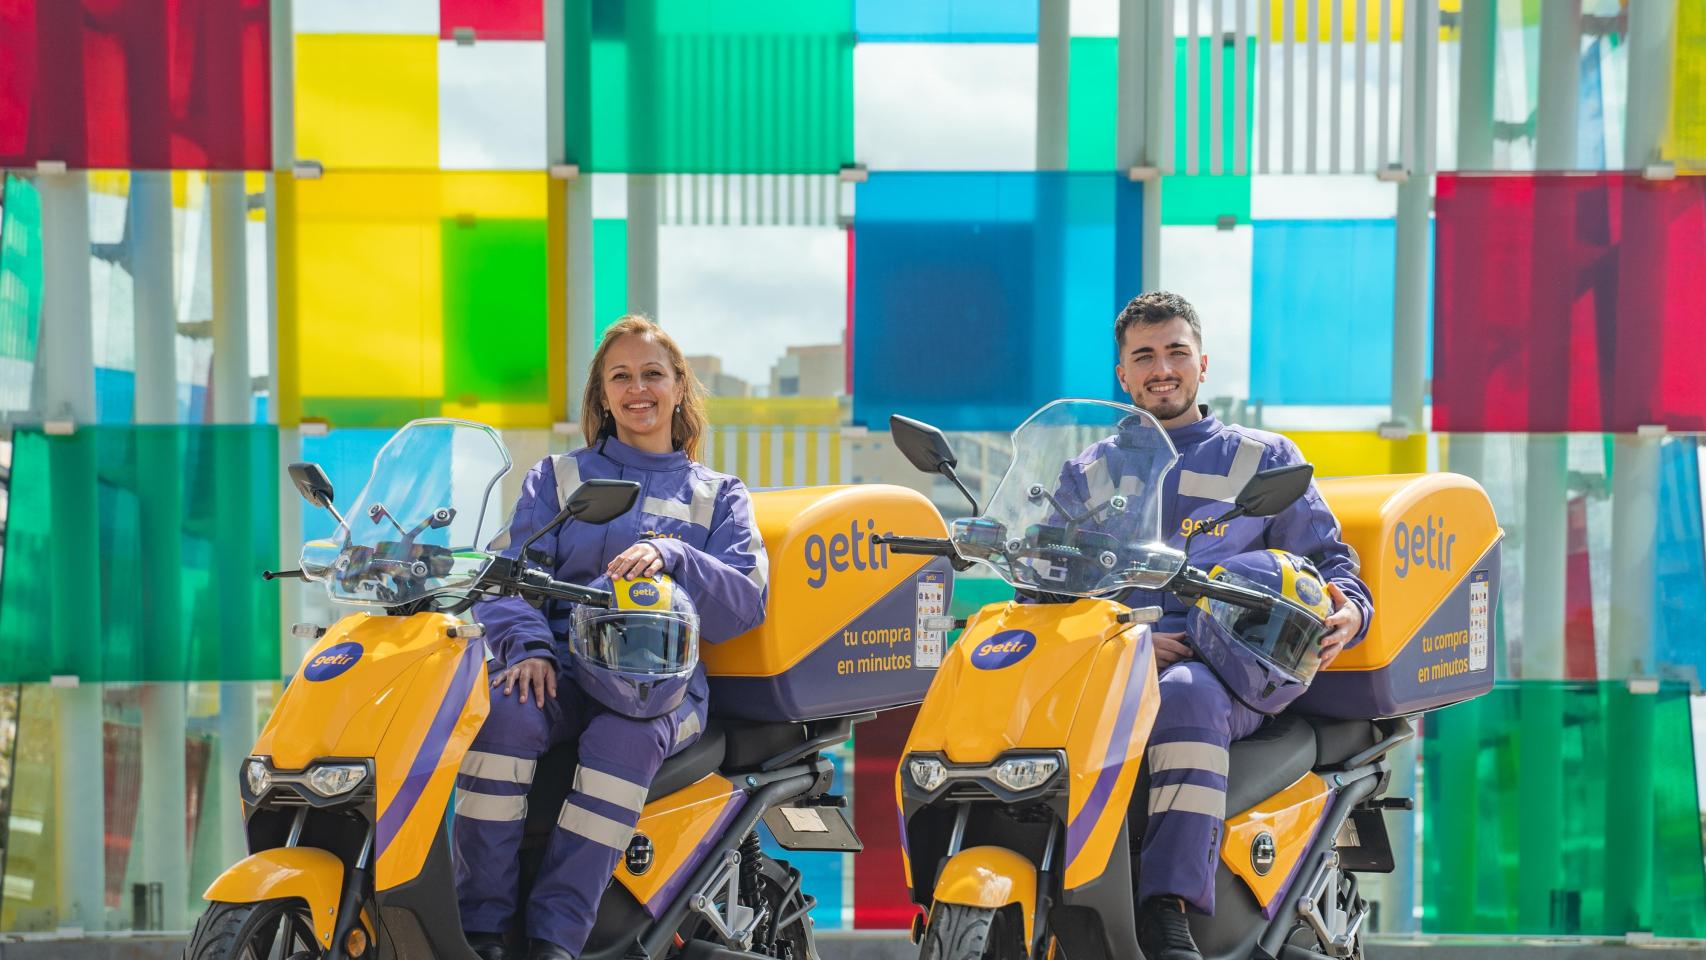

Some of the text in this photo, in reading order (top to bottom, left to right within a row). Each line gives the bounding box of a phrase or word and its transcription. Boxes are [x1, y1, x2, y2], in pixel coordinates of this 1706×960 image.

[805, 518, 894, 589] getir
[1394, 514, 1456, 578] getir
[633, 588, 656, 598] getir
[843, 627, 911, 648] tu compra
[978, 641, 1028, 656] getir
[1422, 630, 1468, 653] tu compra
[311, 653, 354, 668] getir
[837, 652, 912, 675] en minutos
[1418, 658, 1469, 683] en minutos
